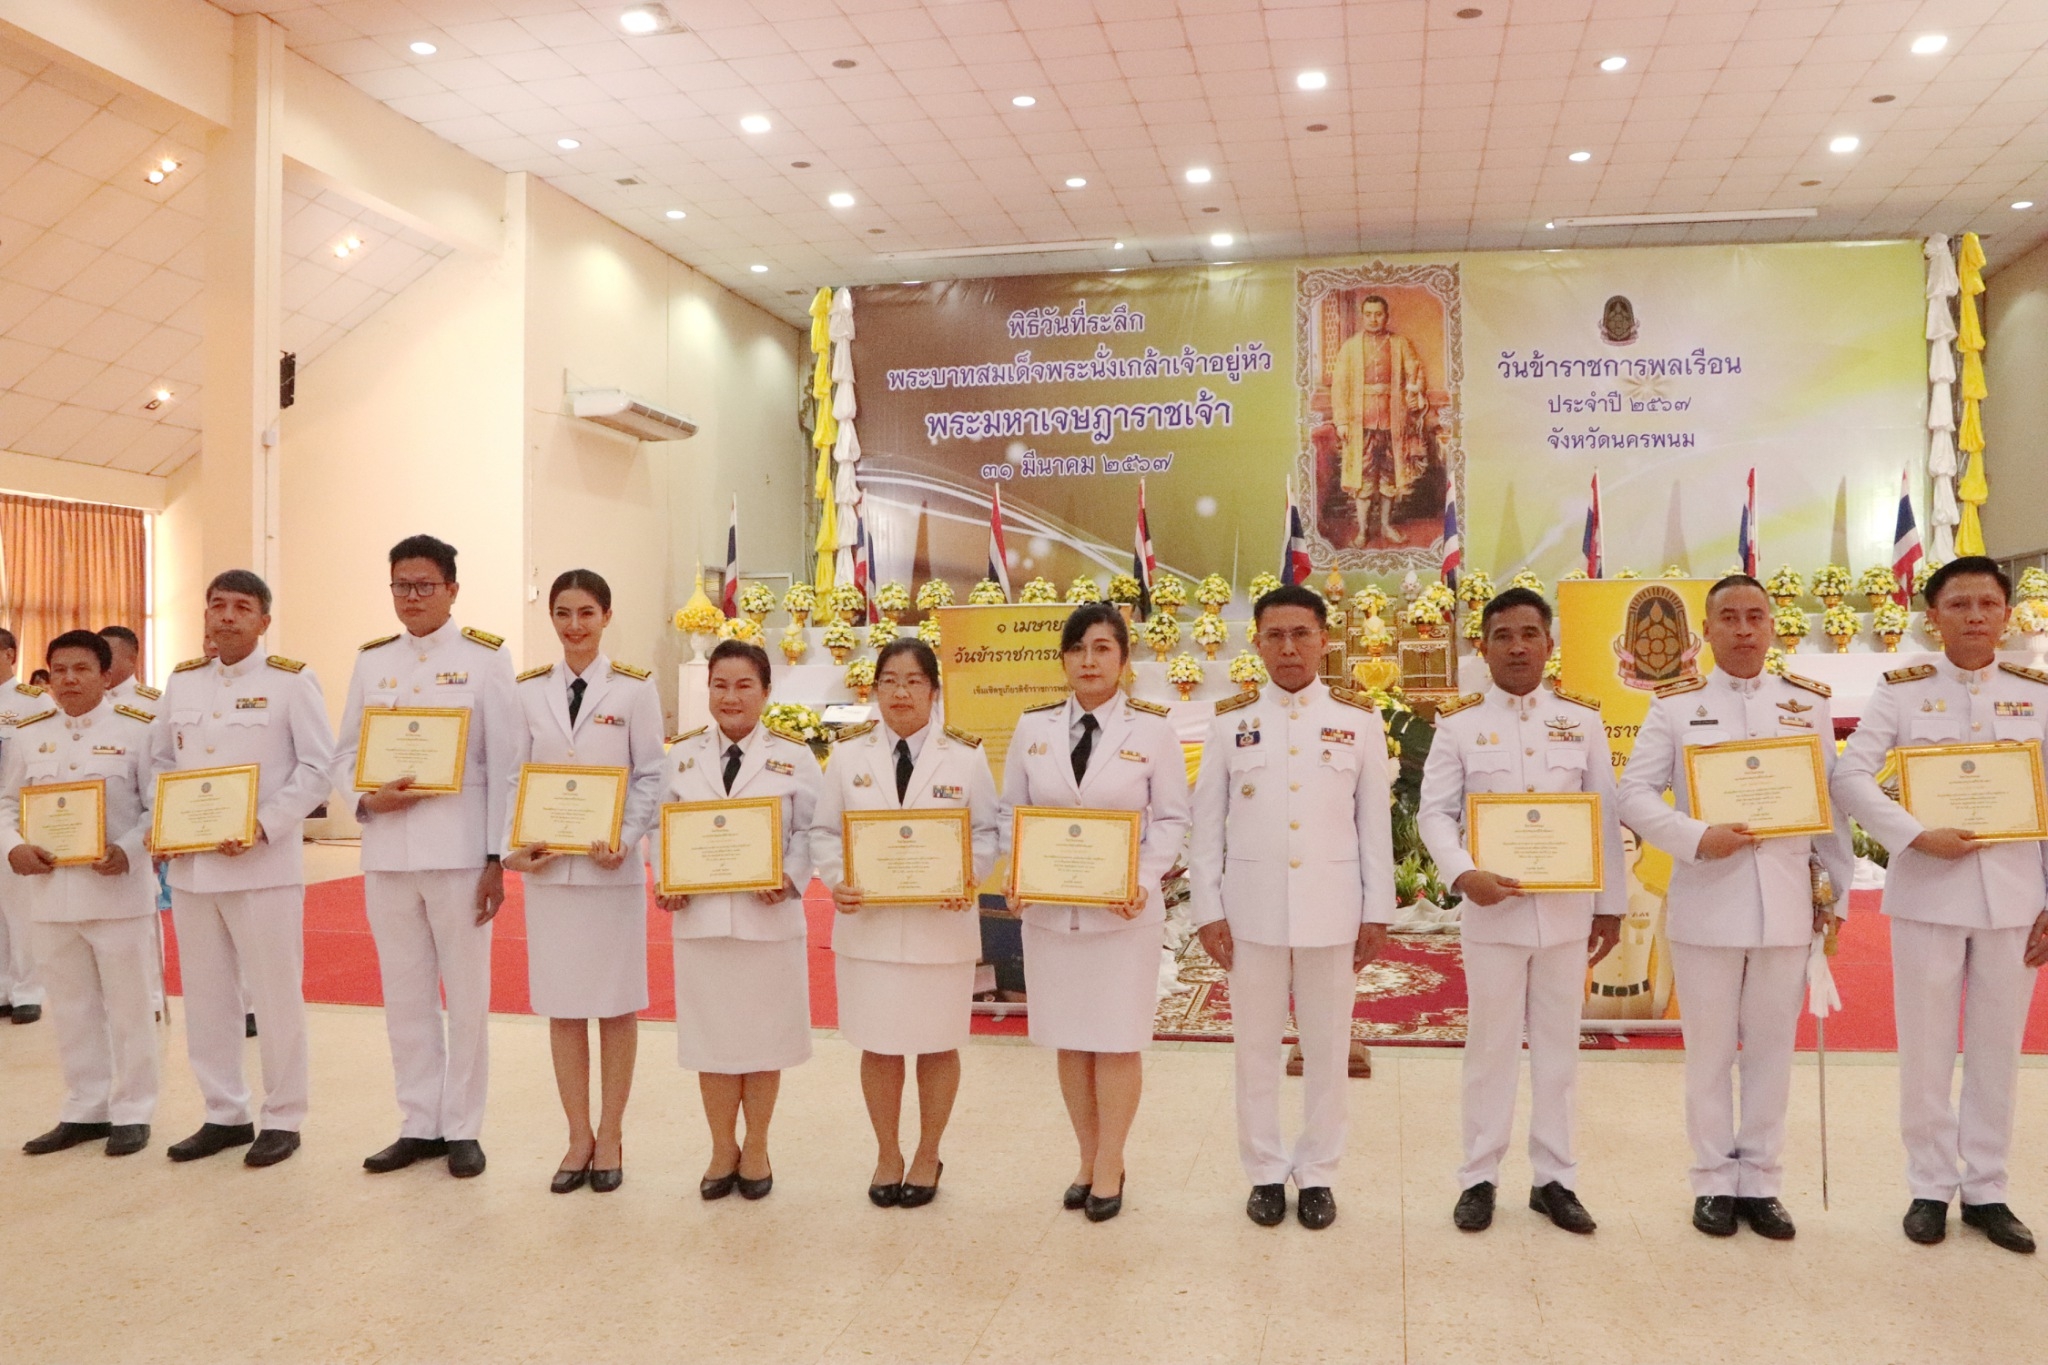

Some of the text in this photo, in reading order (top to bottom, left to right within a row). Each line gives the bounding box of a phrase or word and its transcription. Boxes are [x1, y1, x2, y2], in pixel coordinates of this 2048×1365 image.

[1008, 300, 1144, 339] พิธีวันที่ระลึก
[888, 343, 1271, 390] พระบาทสมเด็จพระนั่งเกล้าเจ้าอยู่หัว
[1498, 348, 1742, 379] วันข้าราชการพลเรือน
[926, 390, 1231, 442] พระมหาเจษฎาราชเจ้า
[1548, 390, 1692, 413] ประจำปี ๒๕๖๗
[1547, 427, 1695, 449] จังหวัดนครพนม
[982, 452, 1173, 480] ๓๑ มีนาคม ๒๕๖๗
[1013, 619, 1065, 633] เมษาย
